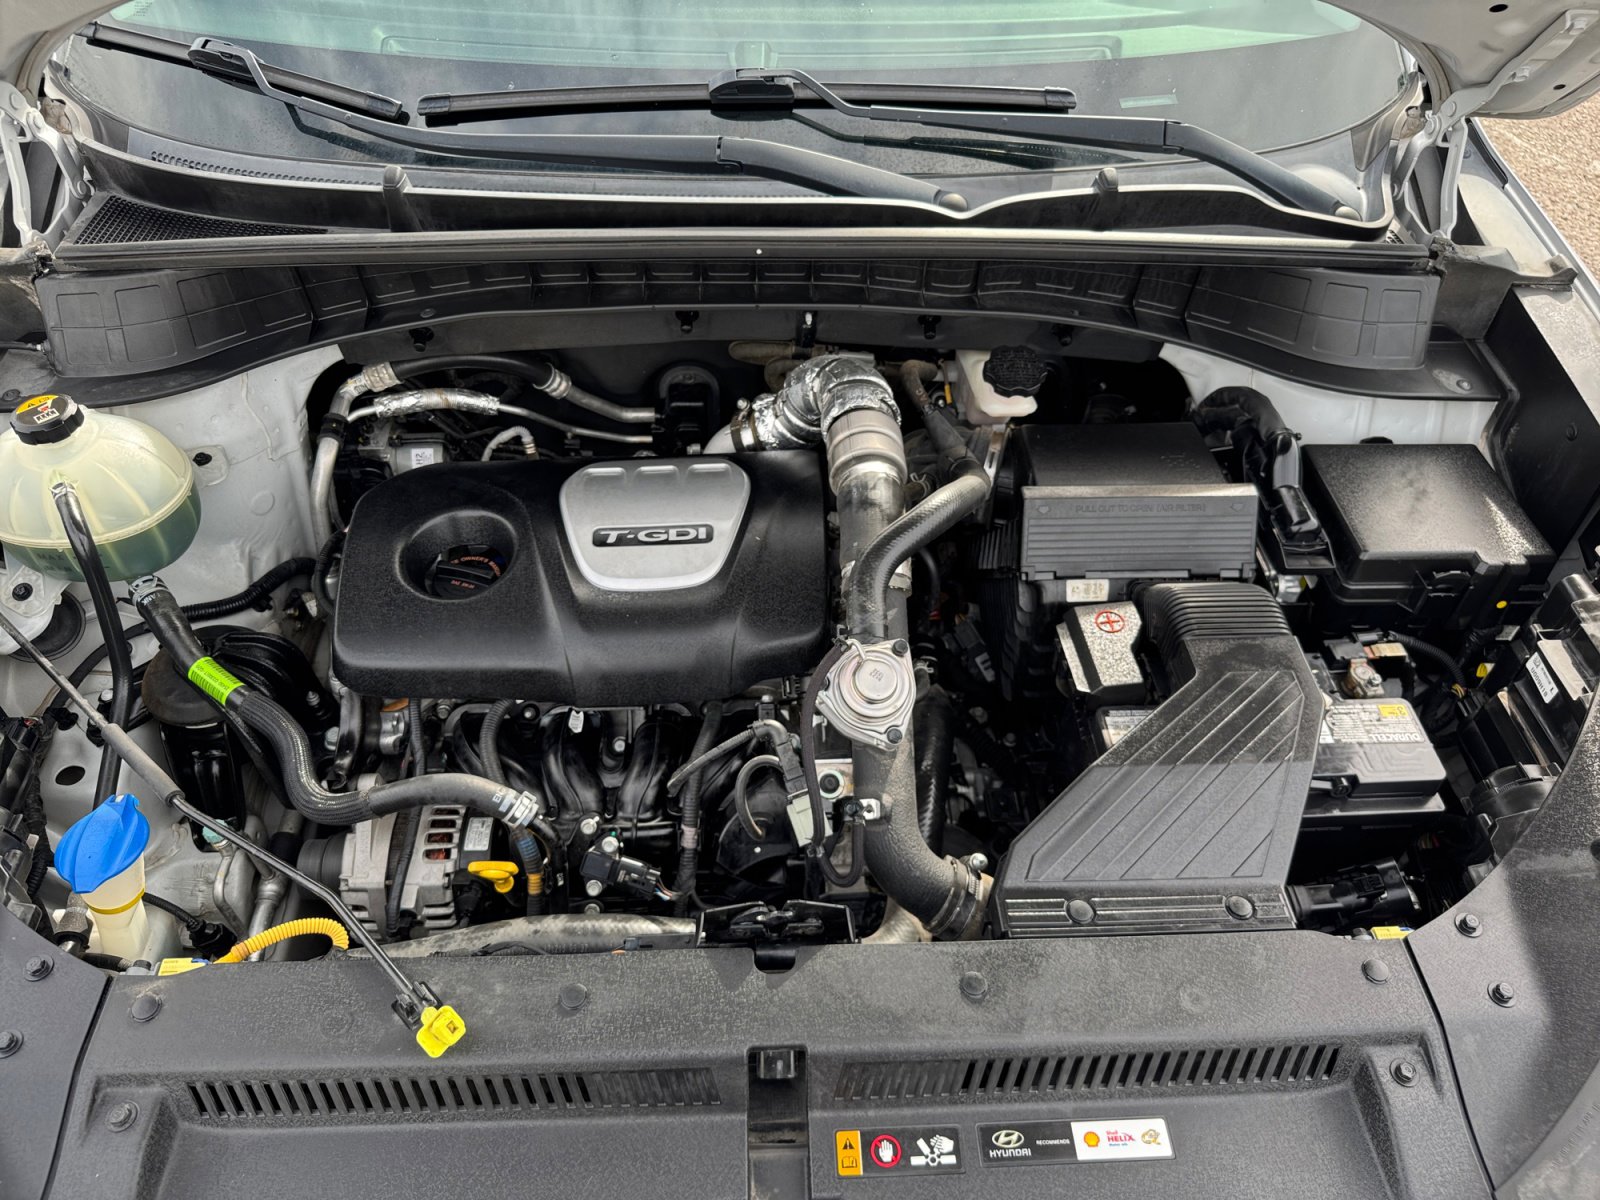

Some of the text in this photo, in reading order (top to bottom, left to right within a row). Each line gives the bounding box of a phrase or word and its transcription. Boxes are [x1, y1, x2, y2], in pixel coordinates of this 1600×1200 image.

[600, 527, 706, 543] T-GDI
[1369, 733, 1421, 742] DURACELL
[1036, 1138, 1070, 1146] RECOMMENDS
[1107, 1135, 1136, 1143] HELIX
[989, 1147, 1032, 1159] HYUNDAI
